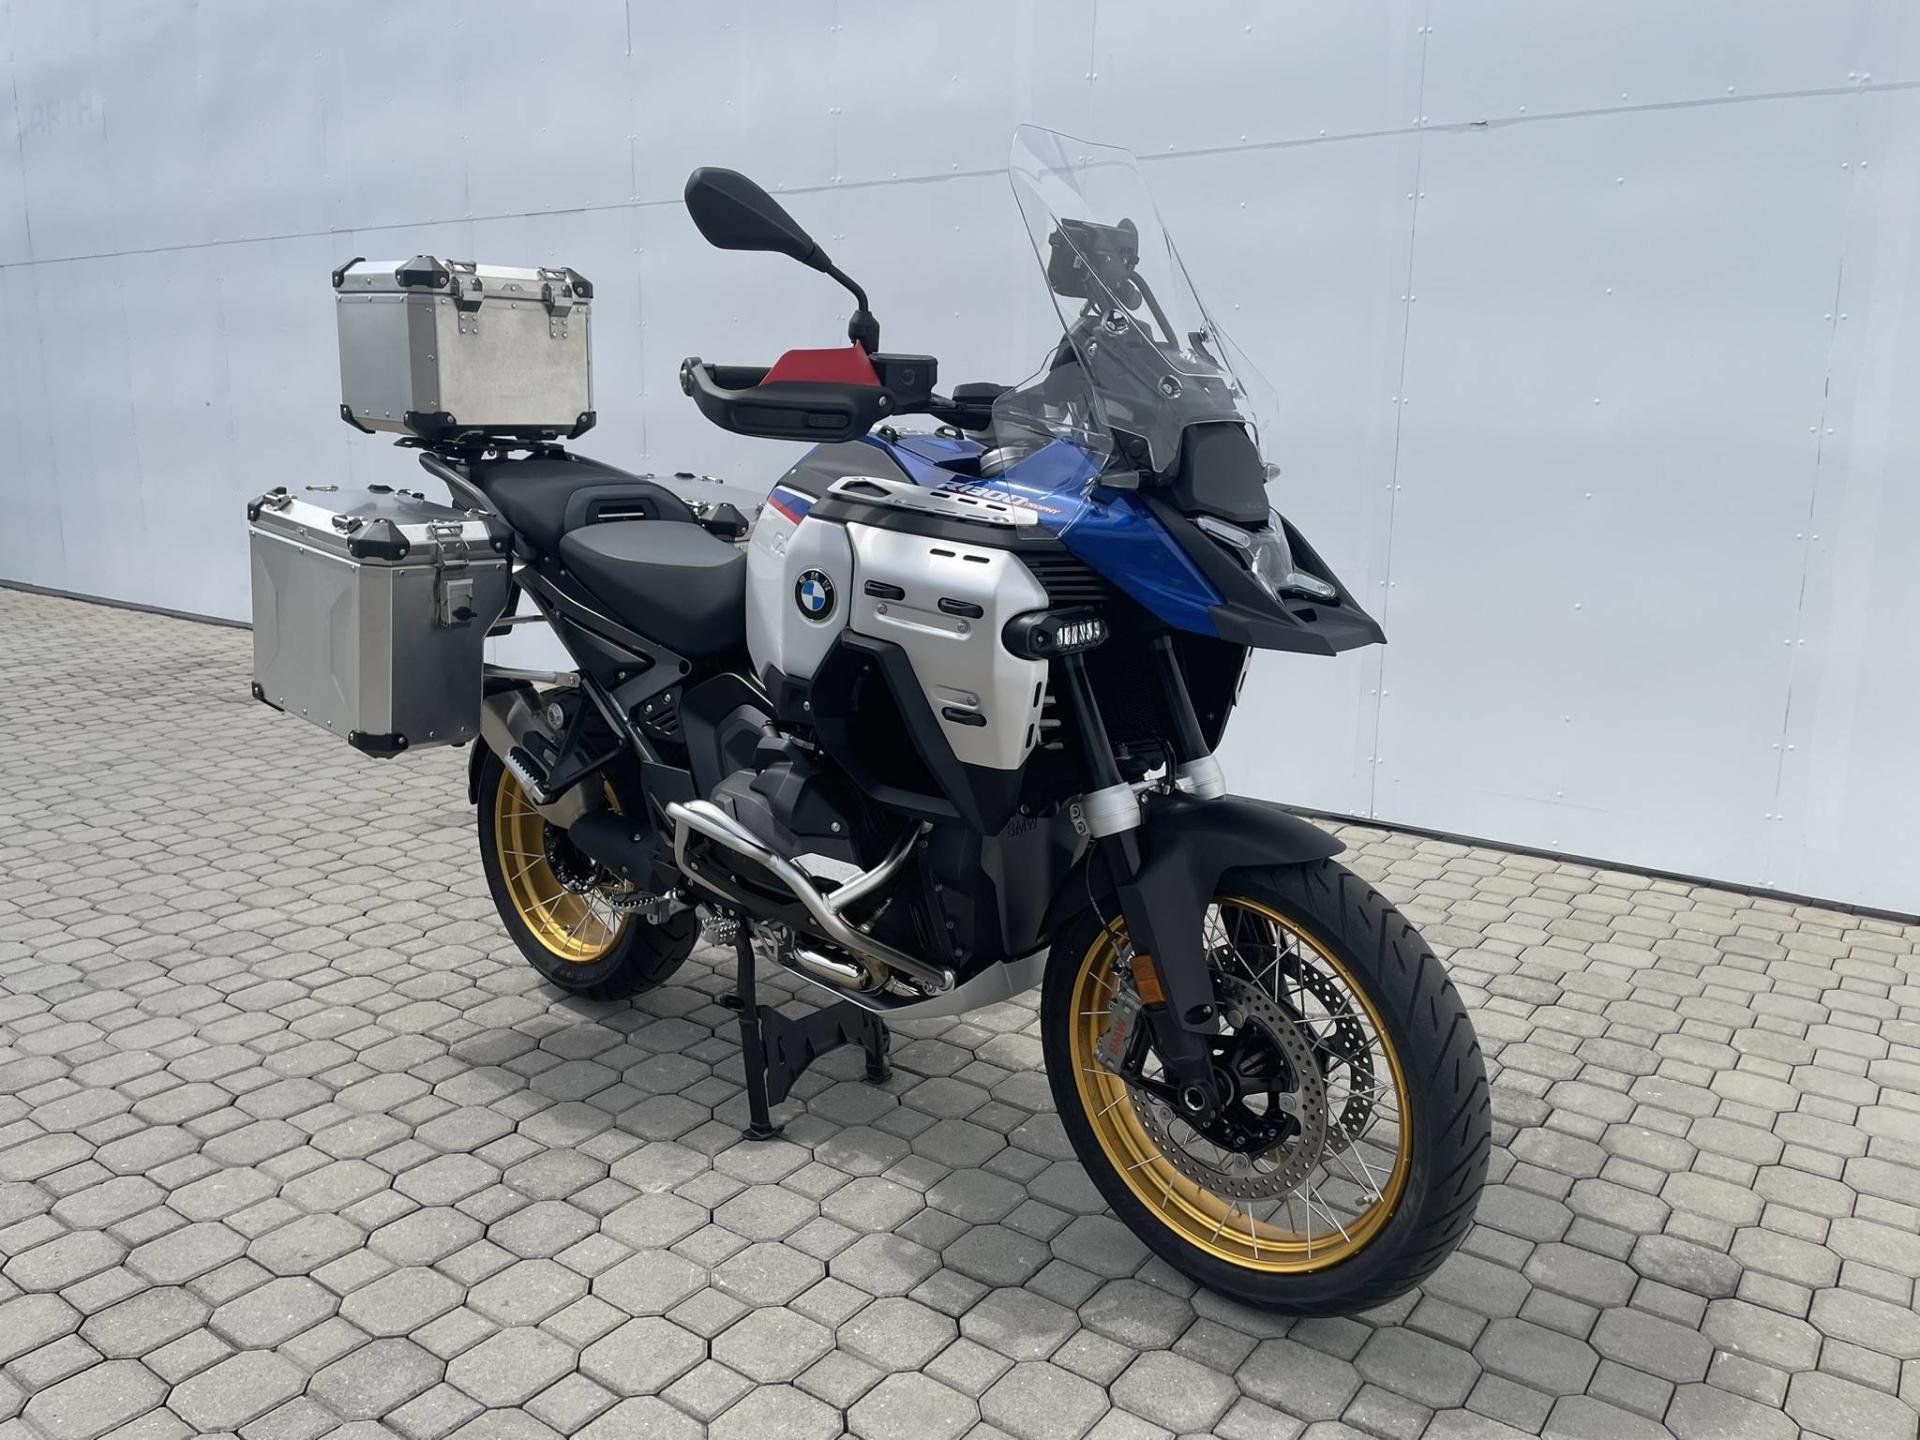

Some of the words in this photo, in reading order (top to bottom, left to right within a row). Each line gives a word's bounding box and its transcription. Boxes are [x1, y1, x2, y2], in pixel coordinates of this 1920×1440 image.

[799, 571, 831, 592] BMW
[1005, 815, 1042, 839] BMW
[1108, 1019, 1127, 1057] BMW
